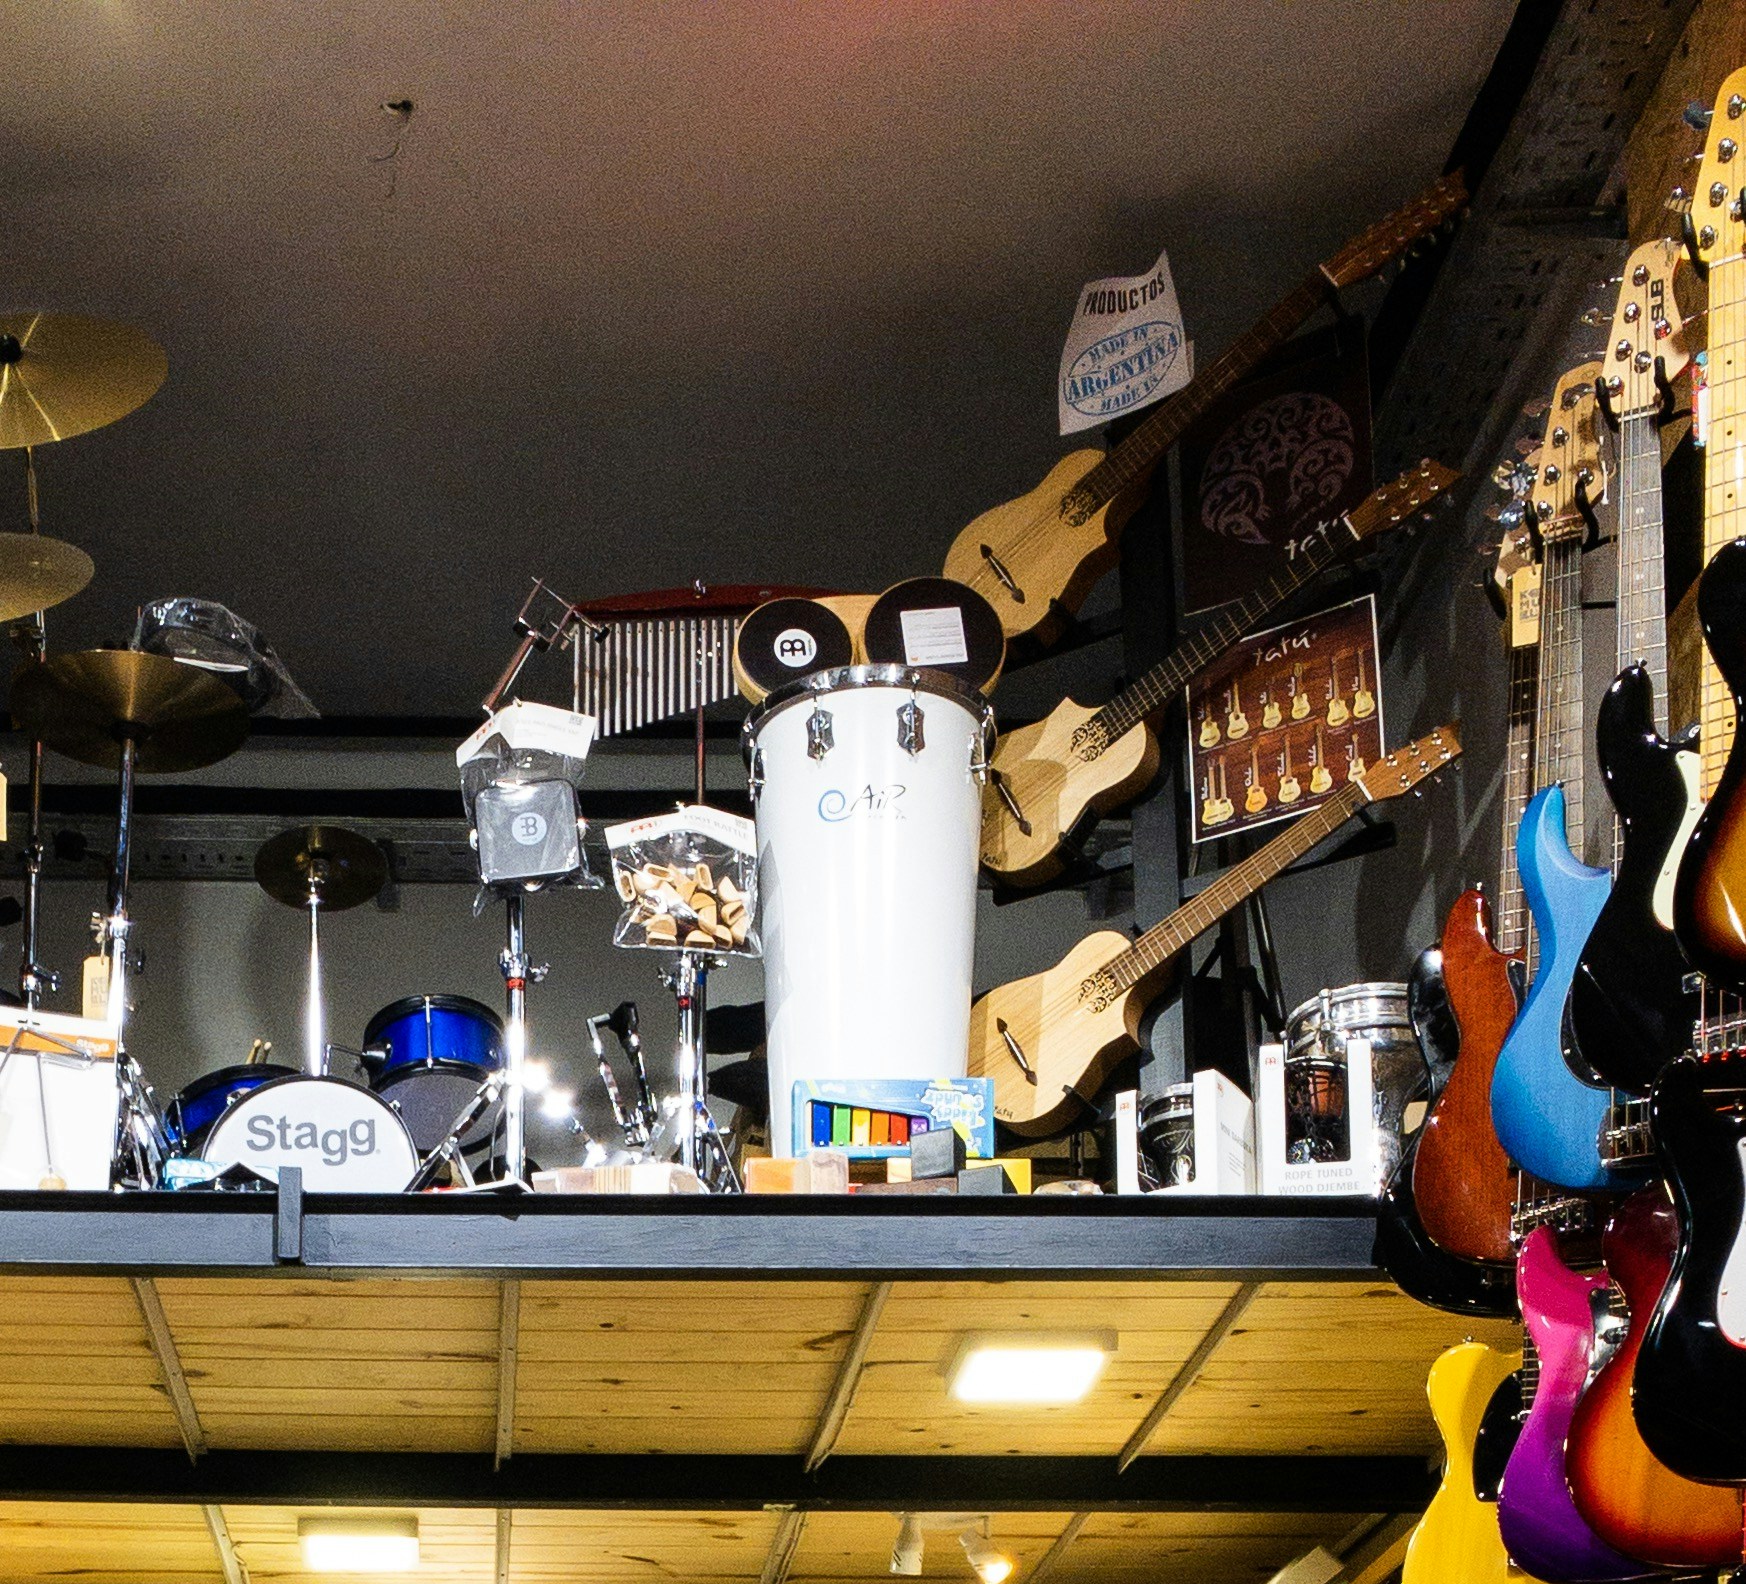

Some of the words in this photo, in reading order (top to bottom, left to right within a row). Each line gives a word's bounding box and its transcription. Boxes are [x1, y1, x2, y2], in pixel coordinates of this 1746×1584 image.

[1083, 271, 1166, 316] PRODUCTOS
[1650, 279, 1665, 321] SUB
[1088, 334, 1129, 363] MADE
[1068, 331, 1179, 402] ARGENTINA
[1101, 387, 1140, 411] MADE
[245, 1114, 377, 1167] Stagg
[1278, 1184, 1313, 1195] WOOD
[1316, 1181, 1360, 1193] DJEMBE
[1285, 1169, 1313, 1180] ROPE
[1317, 1167, 1353, 1178] TUNED
